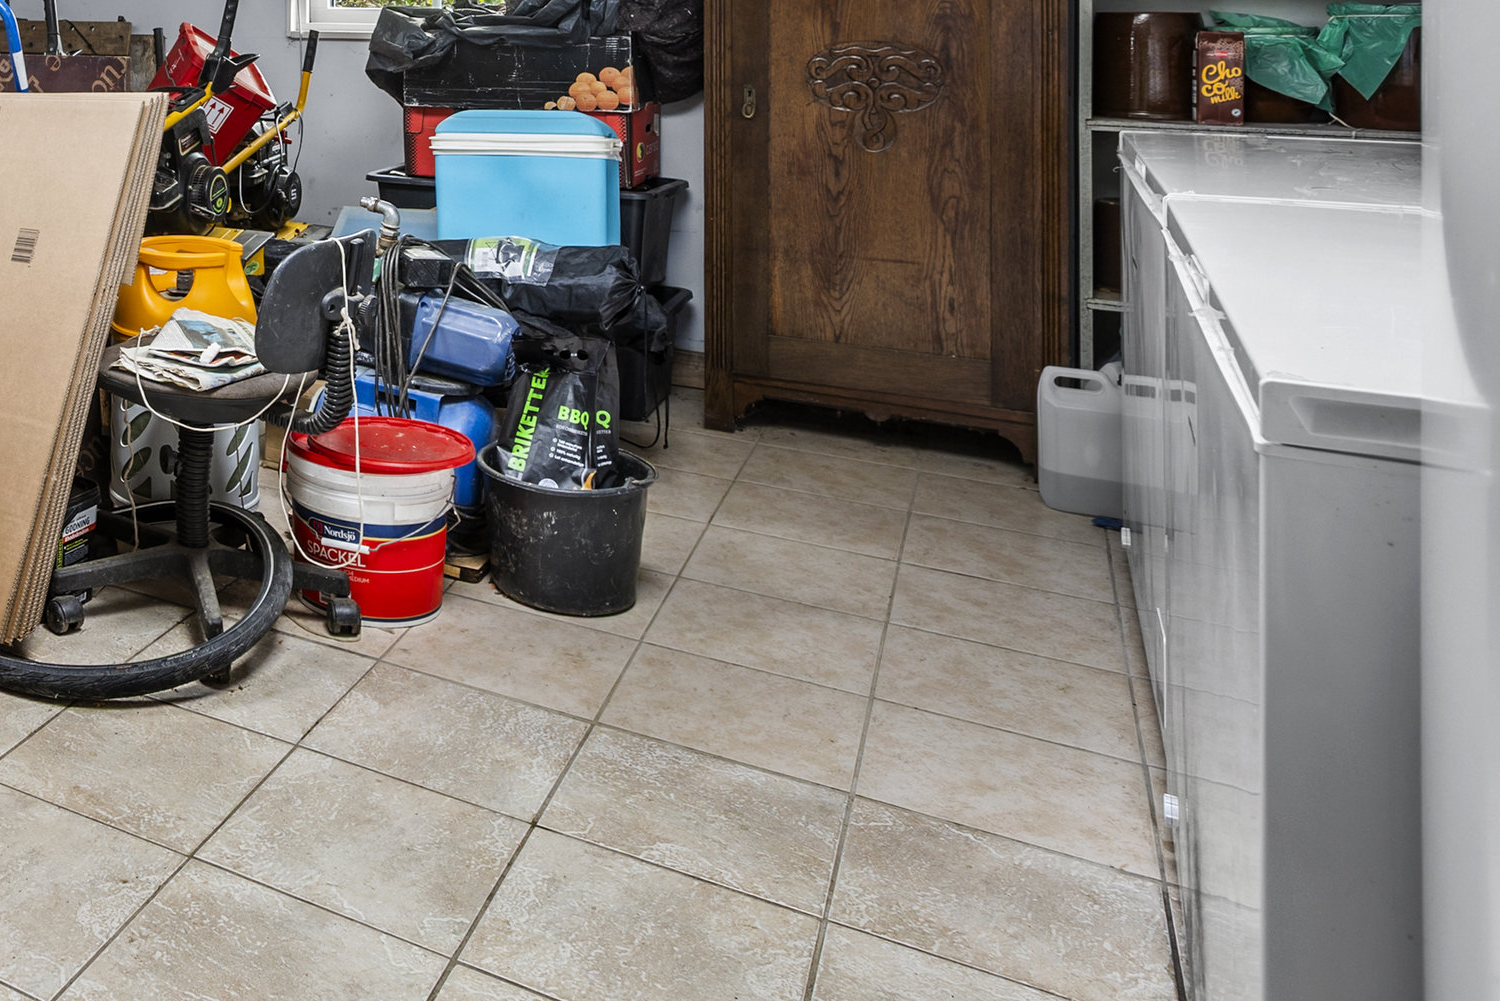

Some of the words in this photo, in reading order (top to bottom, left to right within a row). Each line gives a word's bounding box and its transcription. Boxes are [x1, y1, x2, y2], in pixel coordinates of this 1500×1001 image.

[1210, 86, 1241, 105] milk
[557, 404, 590, 430] BBQ
[323, 524, 357, 542] Nordsjö
[307, 539, 367, 568] SPACKEL
